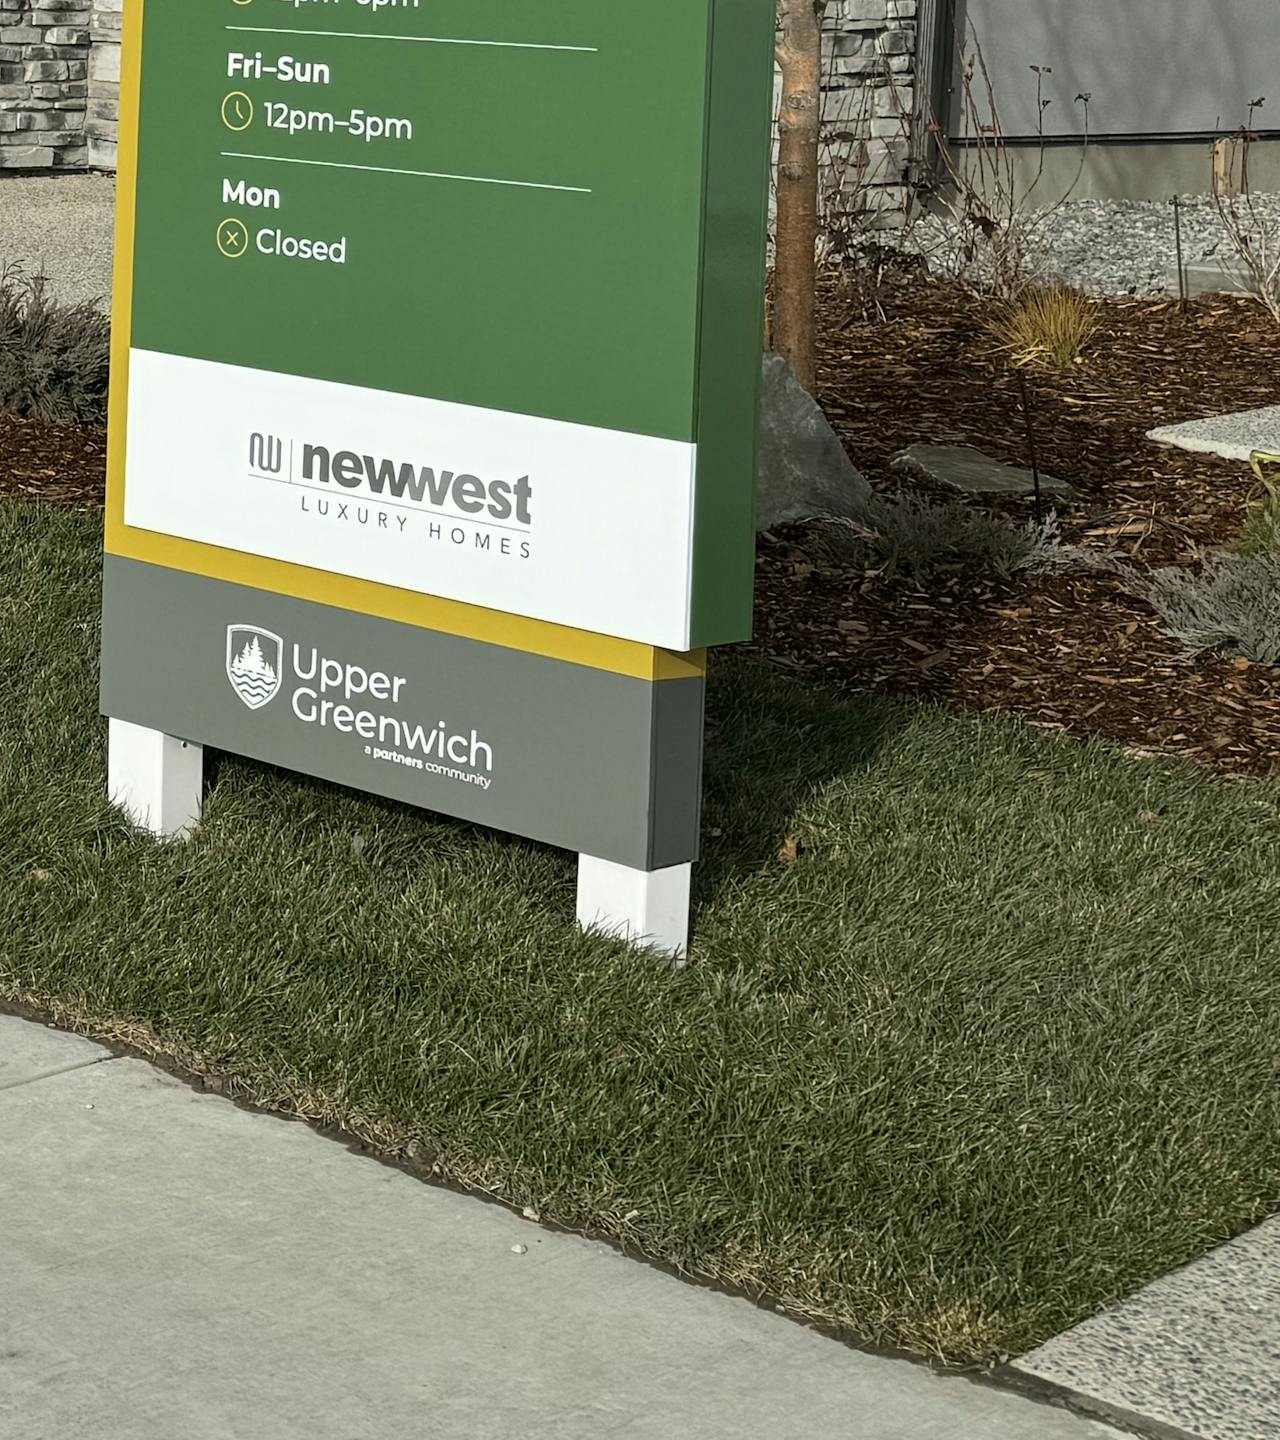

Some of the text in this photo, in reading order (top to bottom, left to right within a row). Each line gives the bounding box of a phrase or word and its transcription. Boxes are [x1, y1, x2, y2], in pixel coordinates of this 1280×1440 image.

[227, 51, 330, 84] Fri–Sun
[263, 102, 412, 142] 12pm–5pm
[222, 178, 280, 209] Mon
[256, 228, 346, 264] Closed
[302, 443, 532, 525] newwest
[301, 495, 531, 559] LUXURY HOMES
[293, 643, 406, 703] Upper
[291, 687, 493, 771] Greenwich
[364, 745, 492, 790] a partners community
